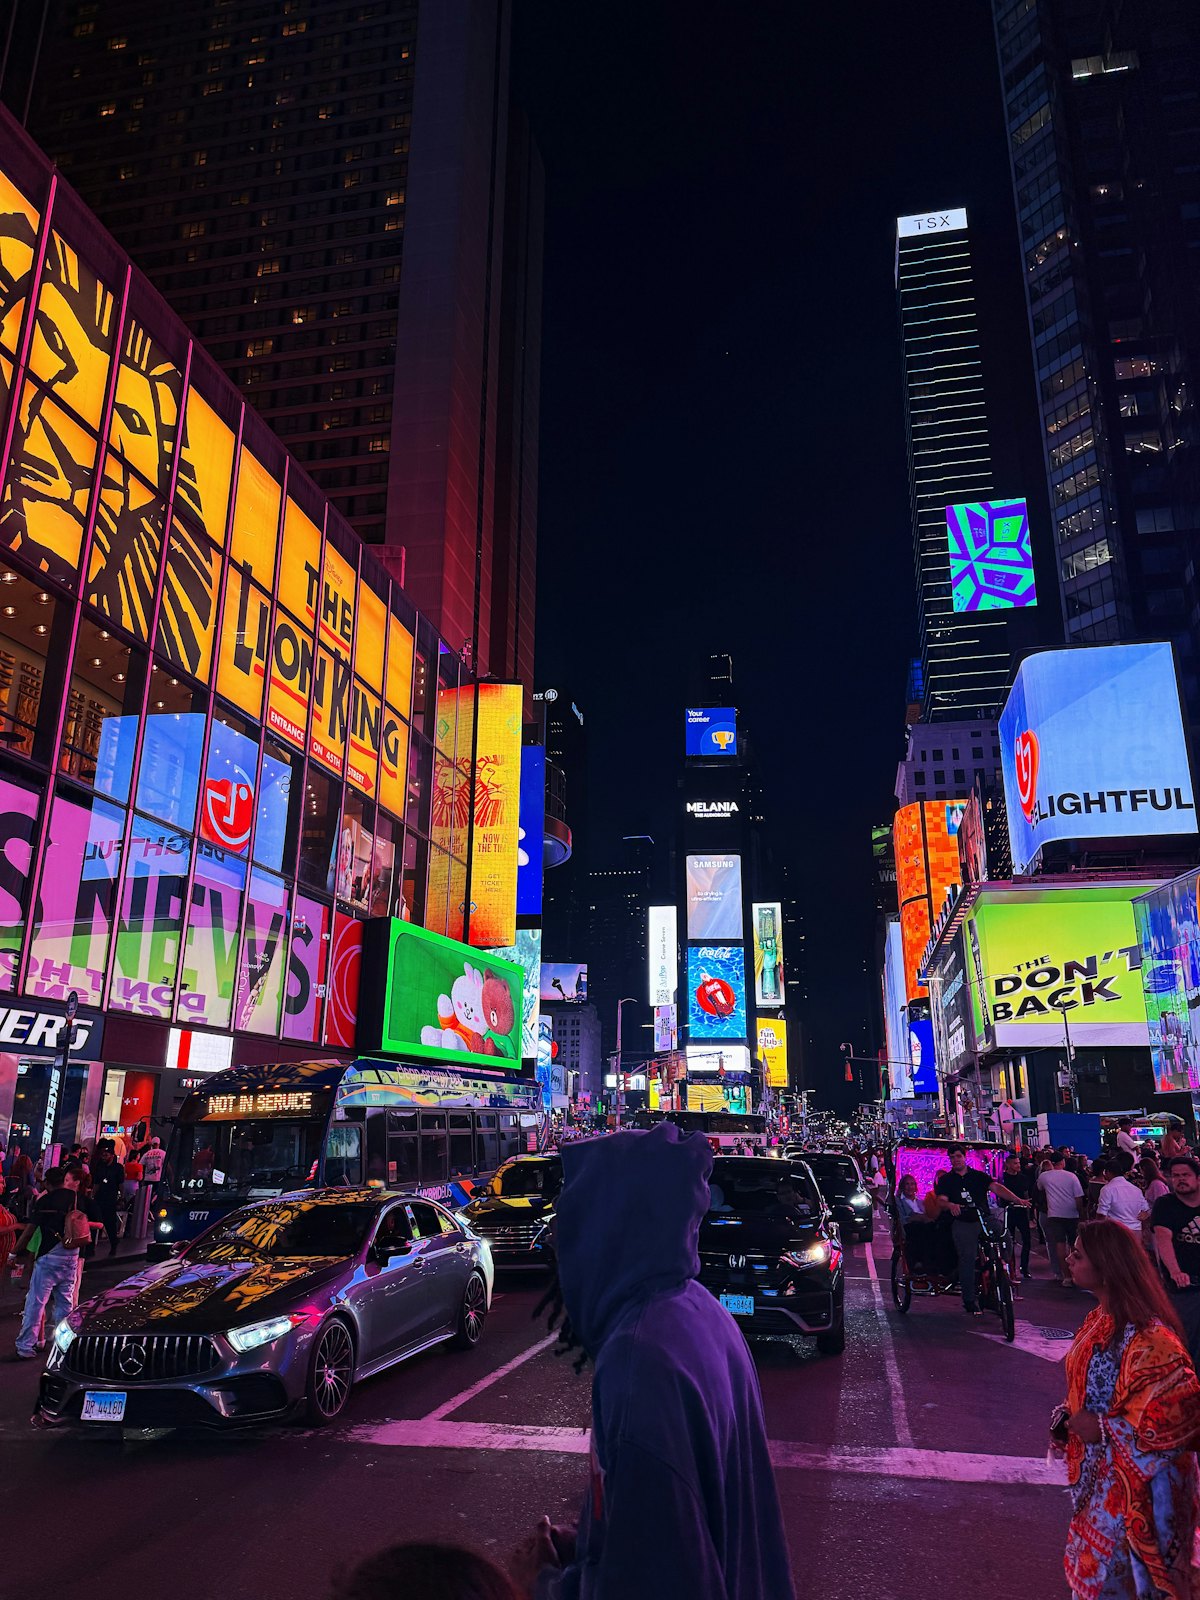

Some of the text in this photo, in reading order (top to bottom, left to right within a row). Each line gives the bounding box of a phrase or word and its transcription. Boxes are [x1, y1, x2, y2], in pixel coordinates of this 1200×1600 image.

[913, 214, 950, 230] TSX
[304, 560, 352, 644] THE
[233, 559, 400, 768] LION KING
[270, 711, 364, 784] ENTRANCE ON 45TH STREET
[686, 802, 739, 812] MELANIA
[482, 833, 499, 843] NOW
[477, 843, 491, 853] THE
[994, 944, 1147, 998] DON'T
[1013, 955, 1051, 973] THE
[992, 975, 1122, 1022] BACK
[759, 1038, 777, 1046] club
[760, 1030, 774, 1038] fun
[208, 1092, 312, 1113] NOT IN SERVICE
[180, 1178, 204, 1188] 140
[189, 1211, 209, 1221] 9777
